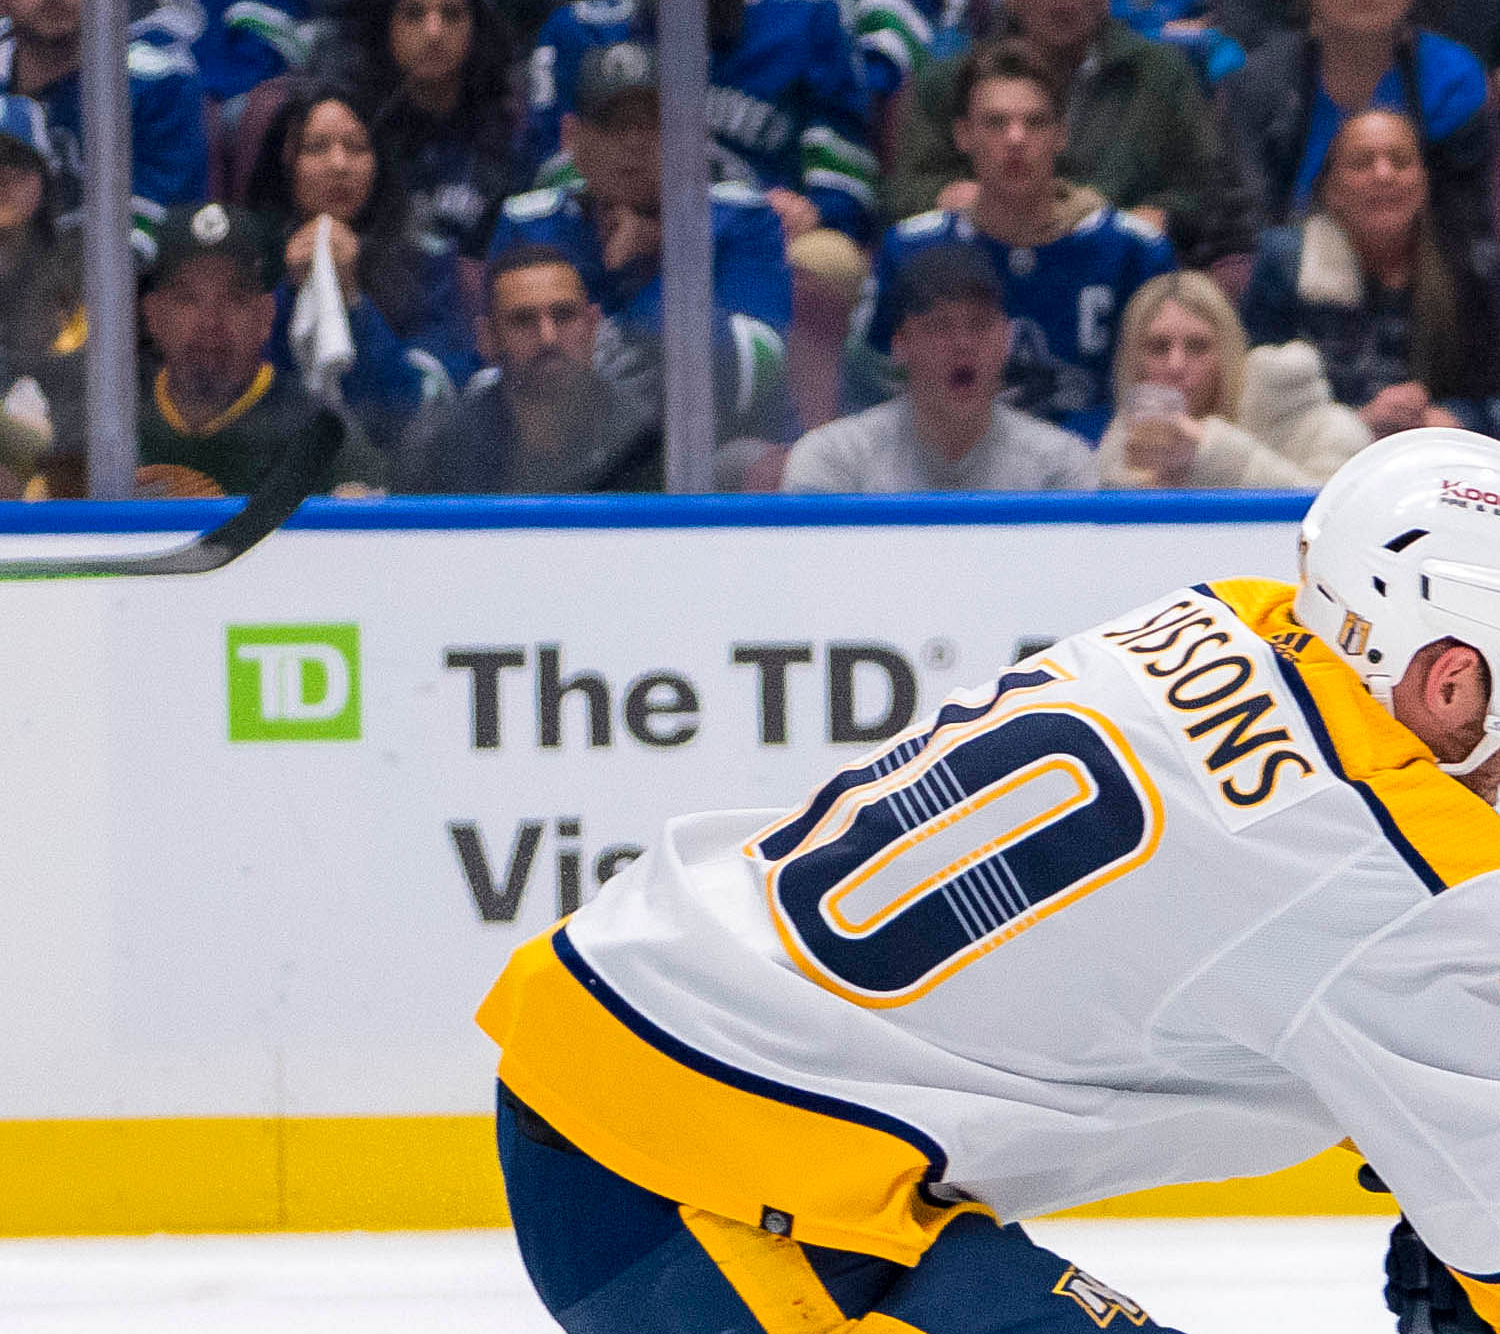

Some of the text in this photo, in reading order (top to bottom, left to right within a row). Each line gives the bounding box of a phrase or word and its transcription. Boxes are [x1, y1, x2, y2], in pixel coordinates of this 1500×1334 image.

[238, 644, 350, 722] TD
[446, 637, 918, 749] The TD
[1101, 600, 1314, 810] SISSONS
[743, 658, 1166, 1010] 10
